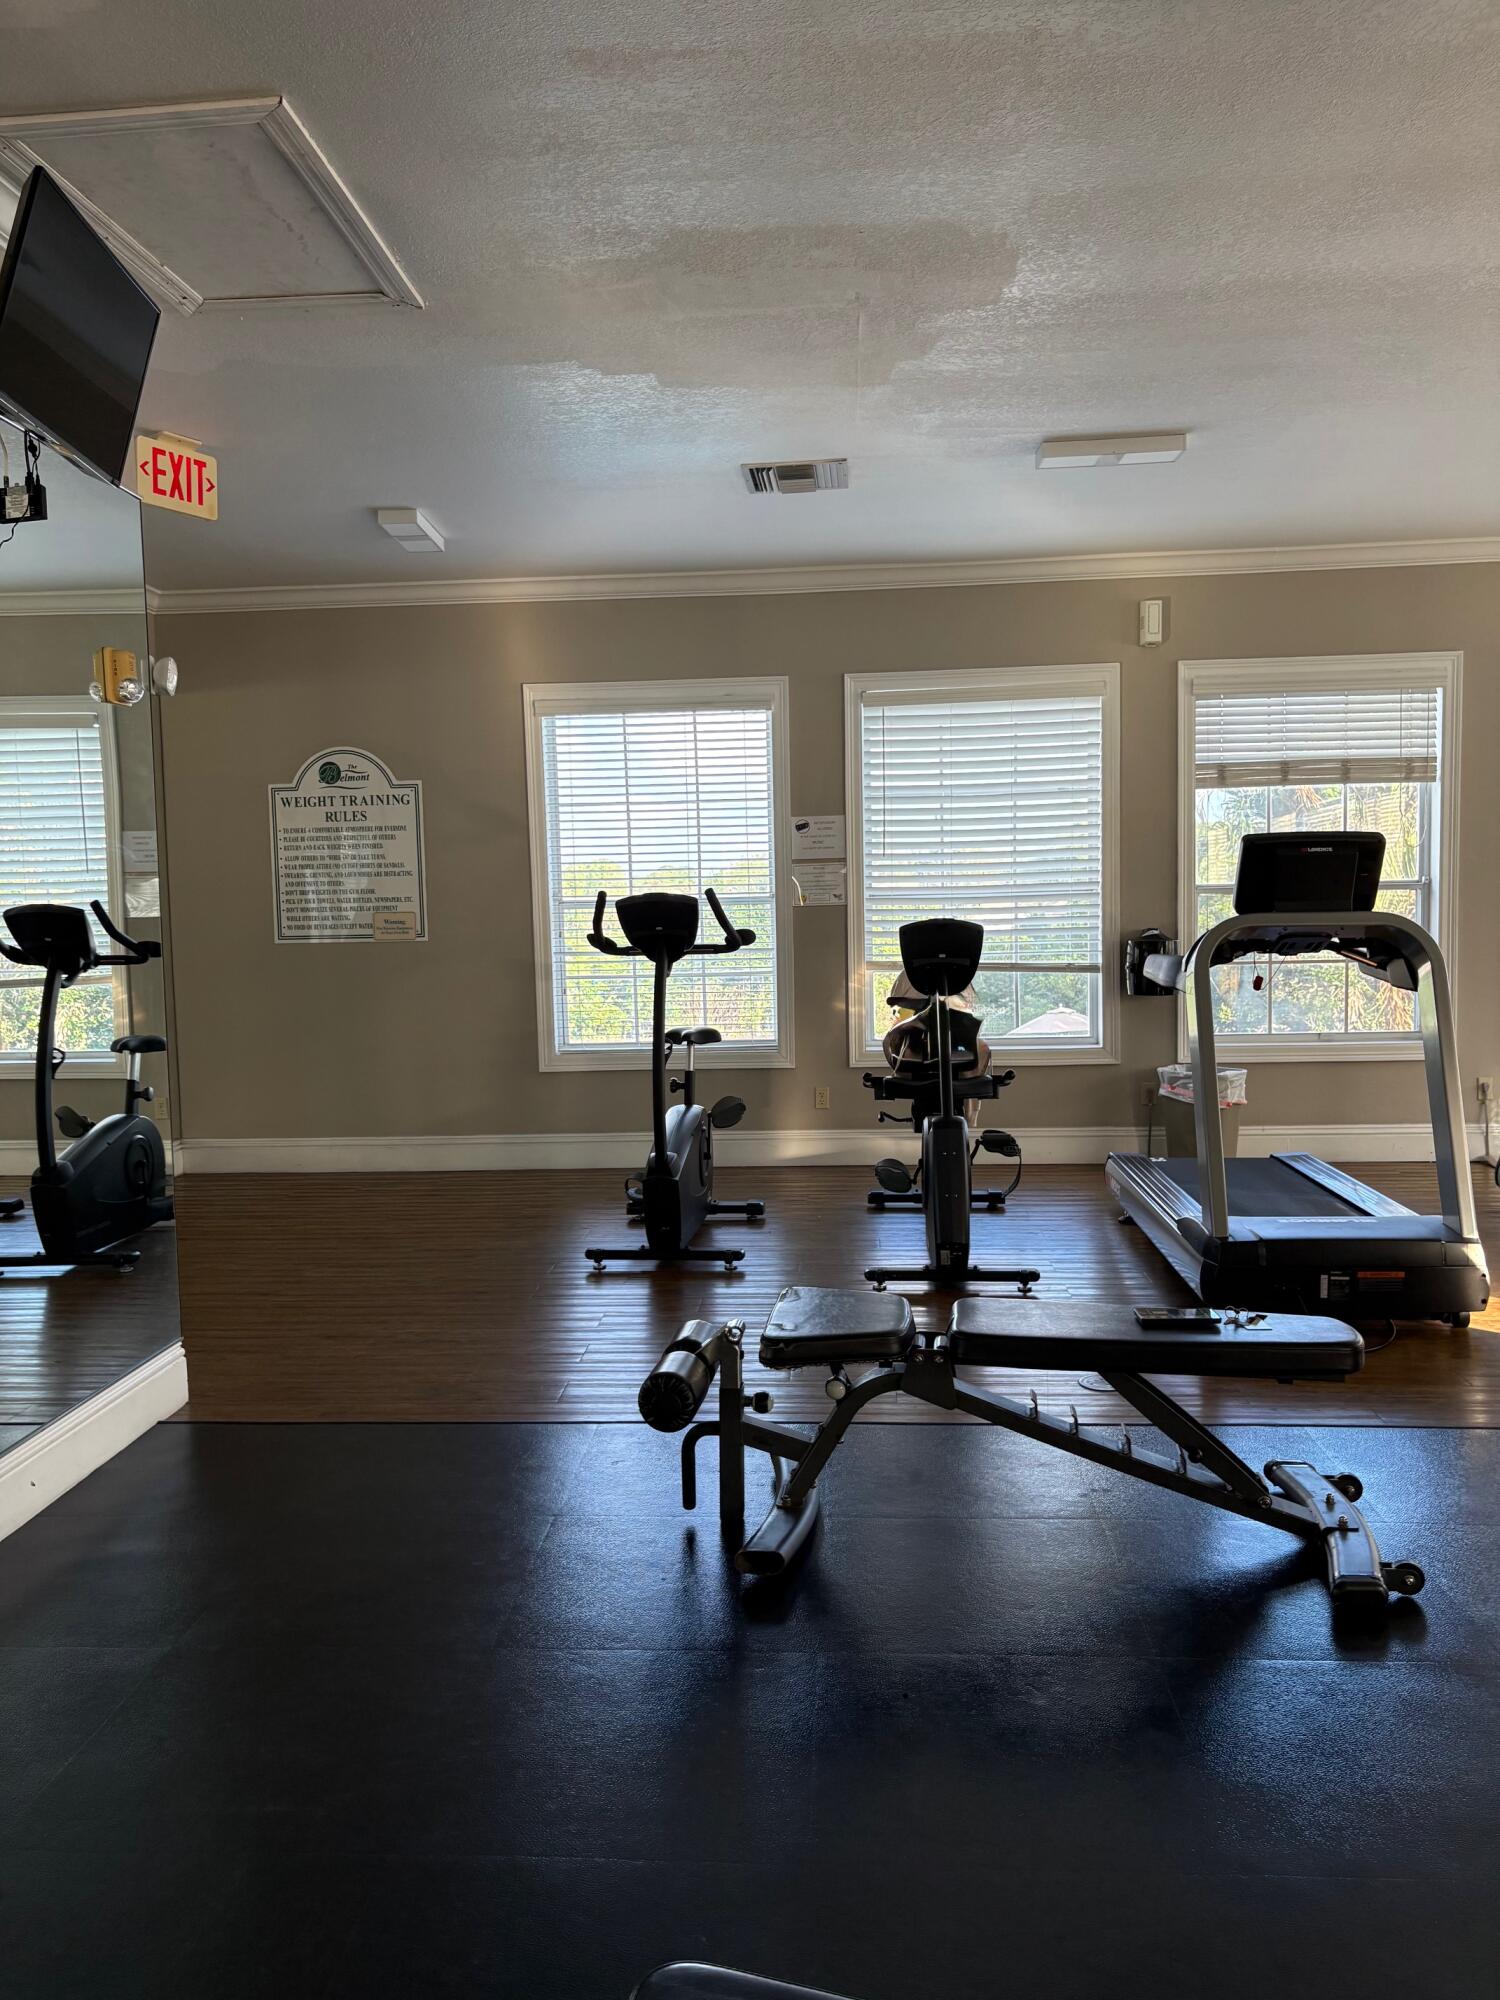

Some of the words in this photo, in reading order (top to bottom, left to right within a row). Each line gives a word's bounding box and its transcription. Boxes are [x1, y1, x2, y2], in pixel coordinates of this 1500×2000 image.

[152, 446, 207, 506] EXIT
[318, 761, 370, 785] Belmont
[280, 795, 336, 808] WEIGHT
[340, 794, 410, 807] TRAINING
[325, 810, 368, 823] RULES
